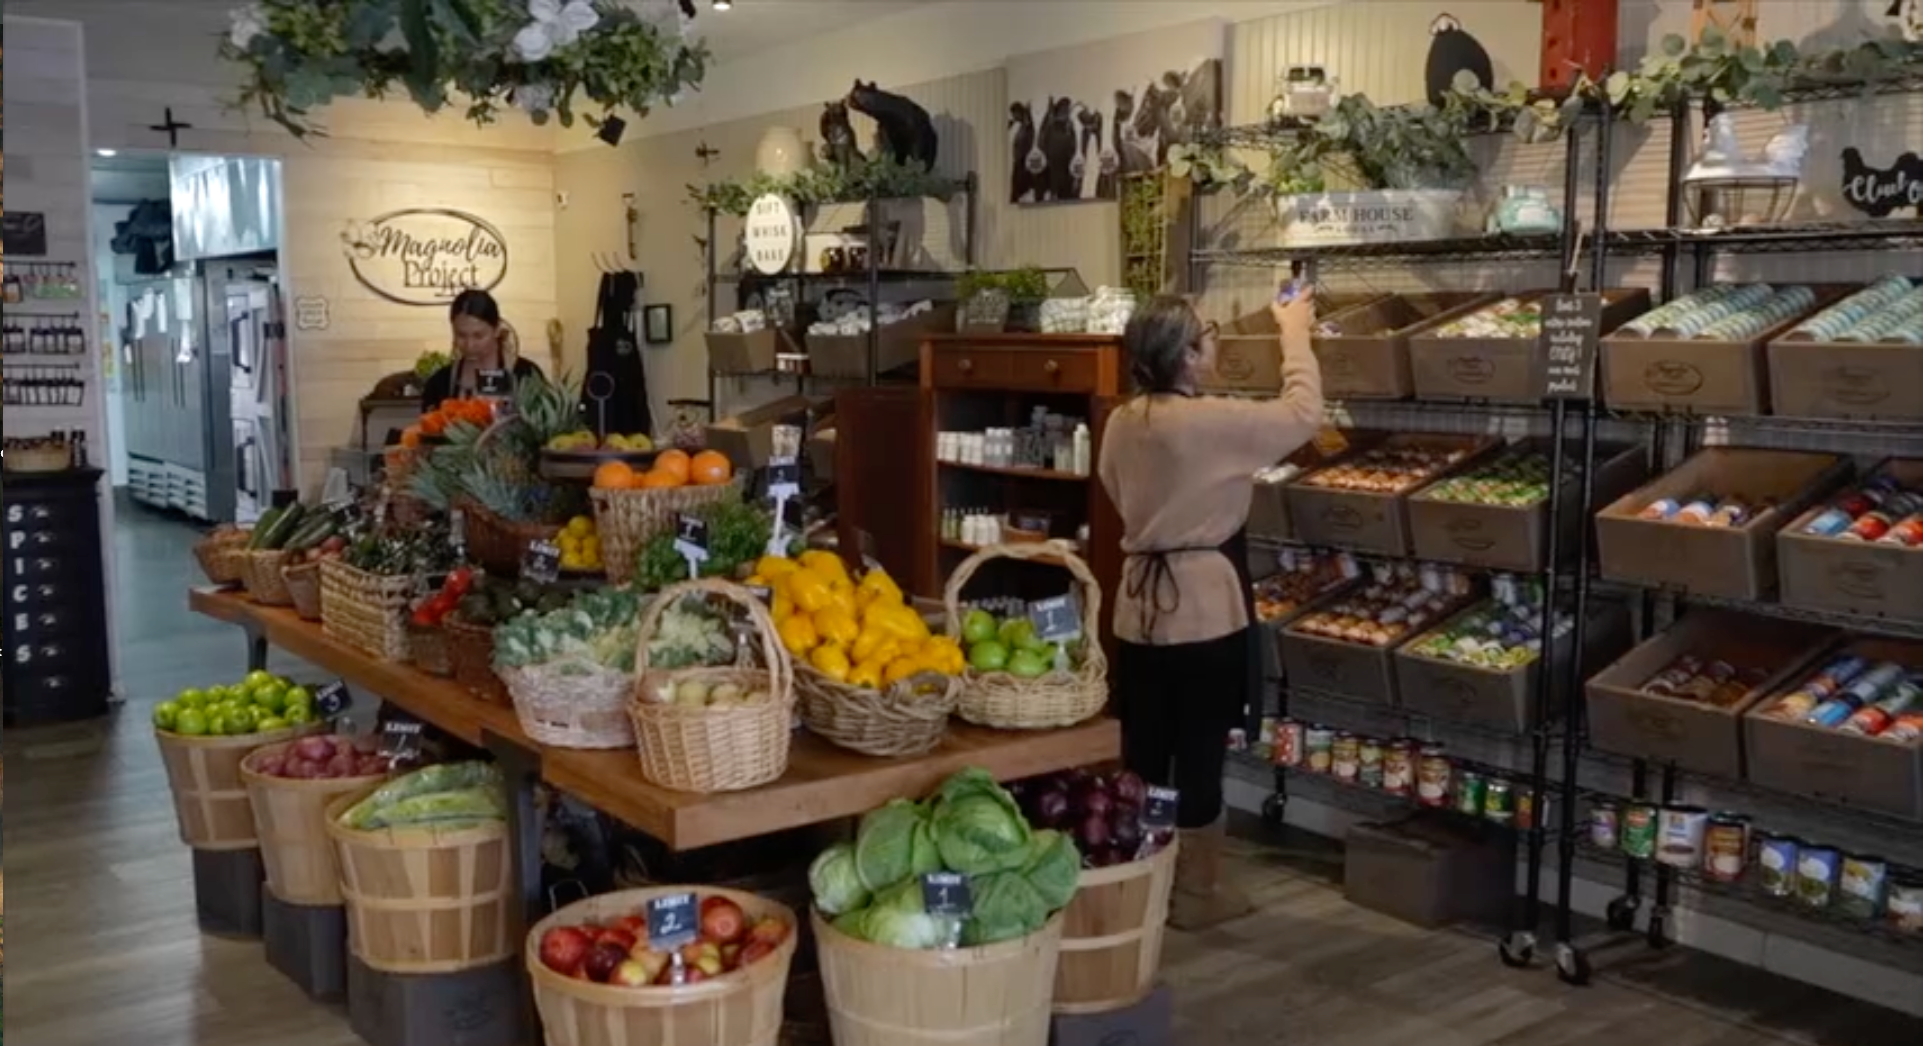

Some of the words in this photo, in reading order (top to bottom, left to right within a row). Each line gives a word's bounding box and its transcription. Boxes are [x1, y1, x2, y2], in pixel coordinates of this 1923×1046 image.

[1353, 206, 1415, 222] HOUSE
[753, 225, 787, 238] WHISK
[379, 225, 501, 270] Magnolia
[403, 260, 480, 297] Project
[8, 504, 31, 664] SPICES
[654, 894, 690, 910] LIMIT
[660, 912, 683, 934] 2
